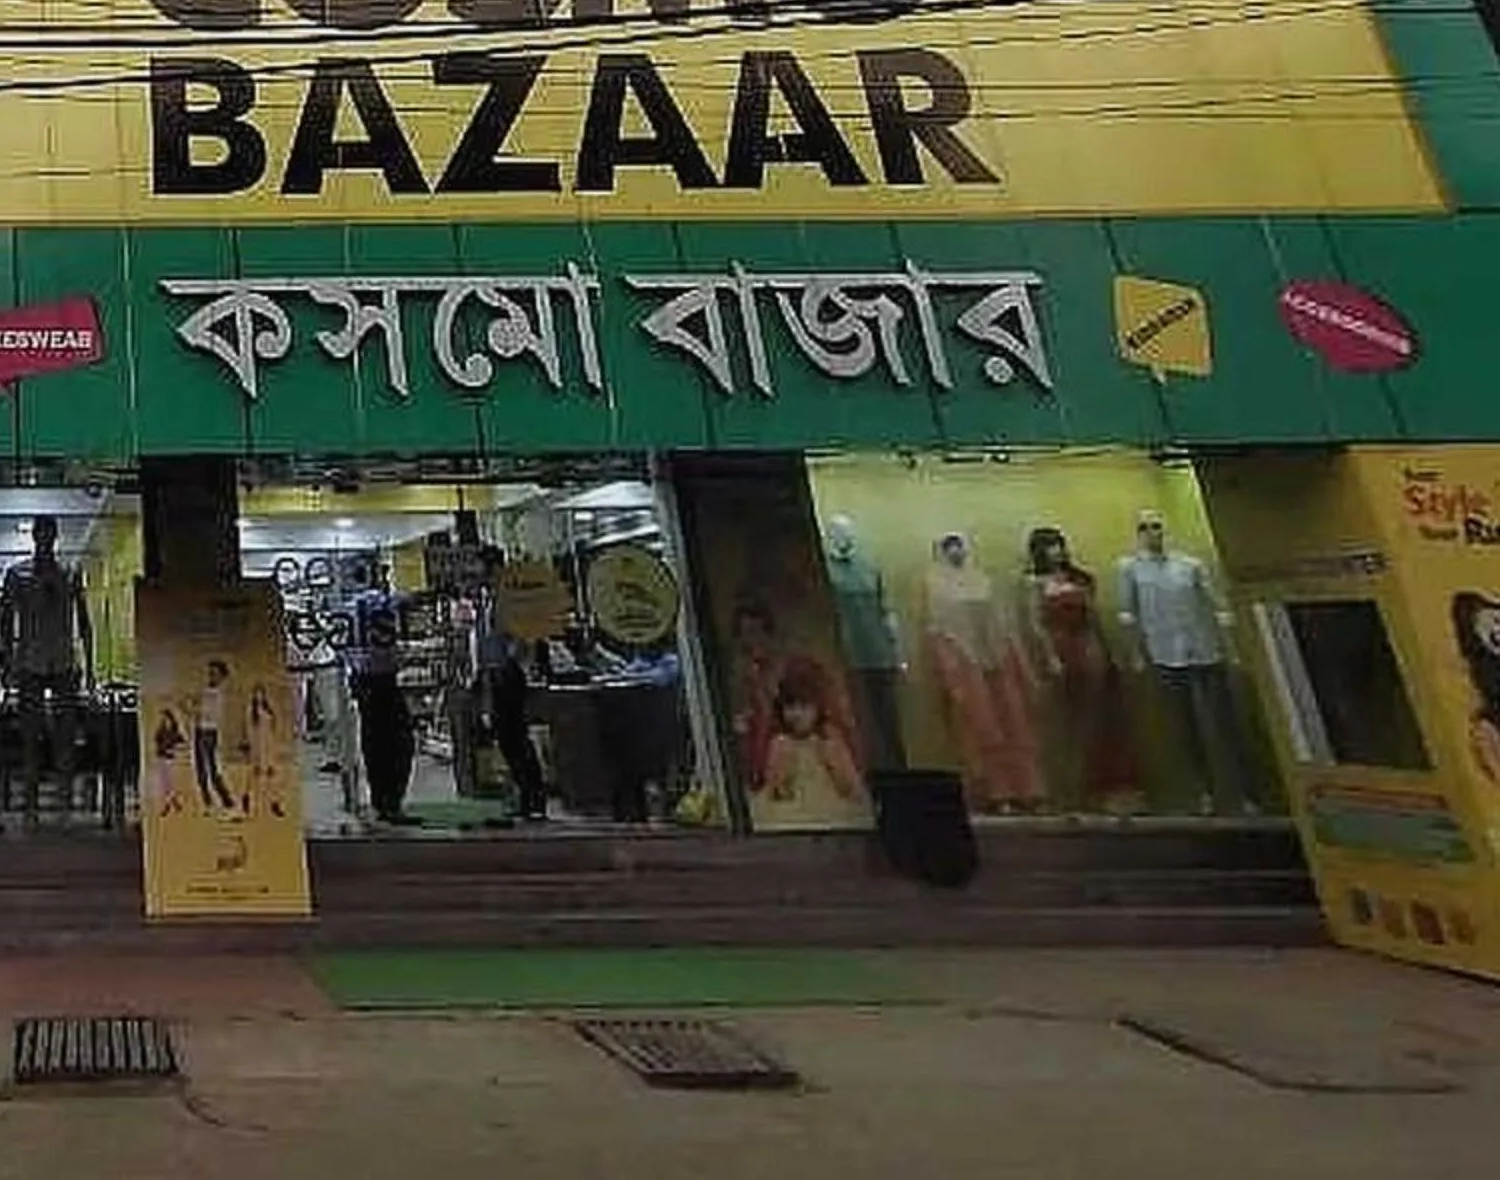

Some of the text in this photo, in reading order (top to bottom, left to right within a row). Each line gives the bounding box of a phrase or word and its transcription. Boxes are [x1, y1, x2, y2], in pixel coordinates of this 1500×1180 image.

[150, 48, 1001, 194] BAZAAR
[159, 260, 1052, 398] কসমো বাজার
